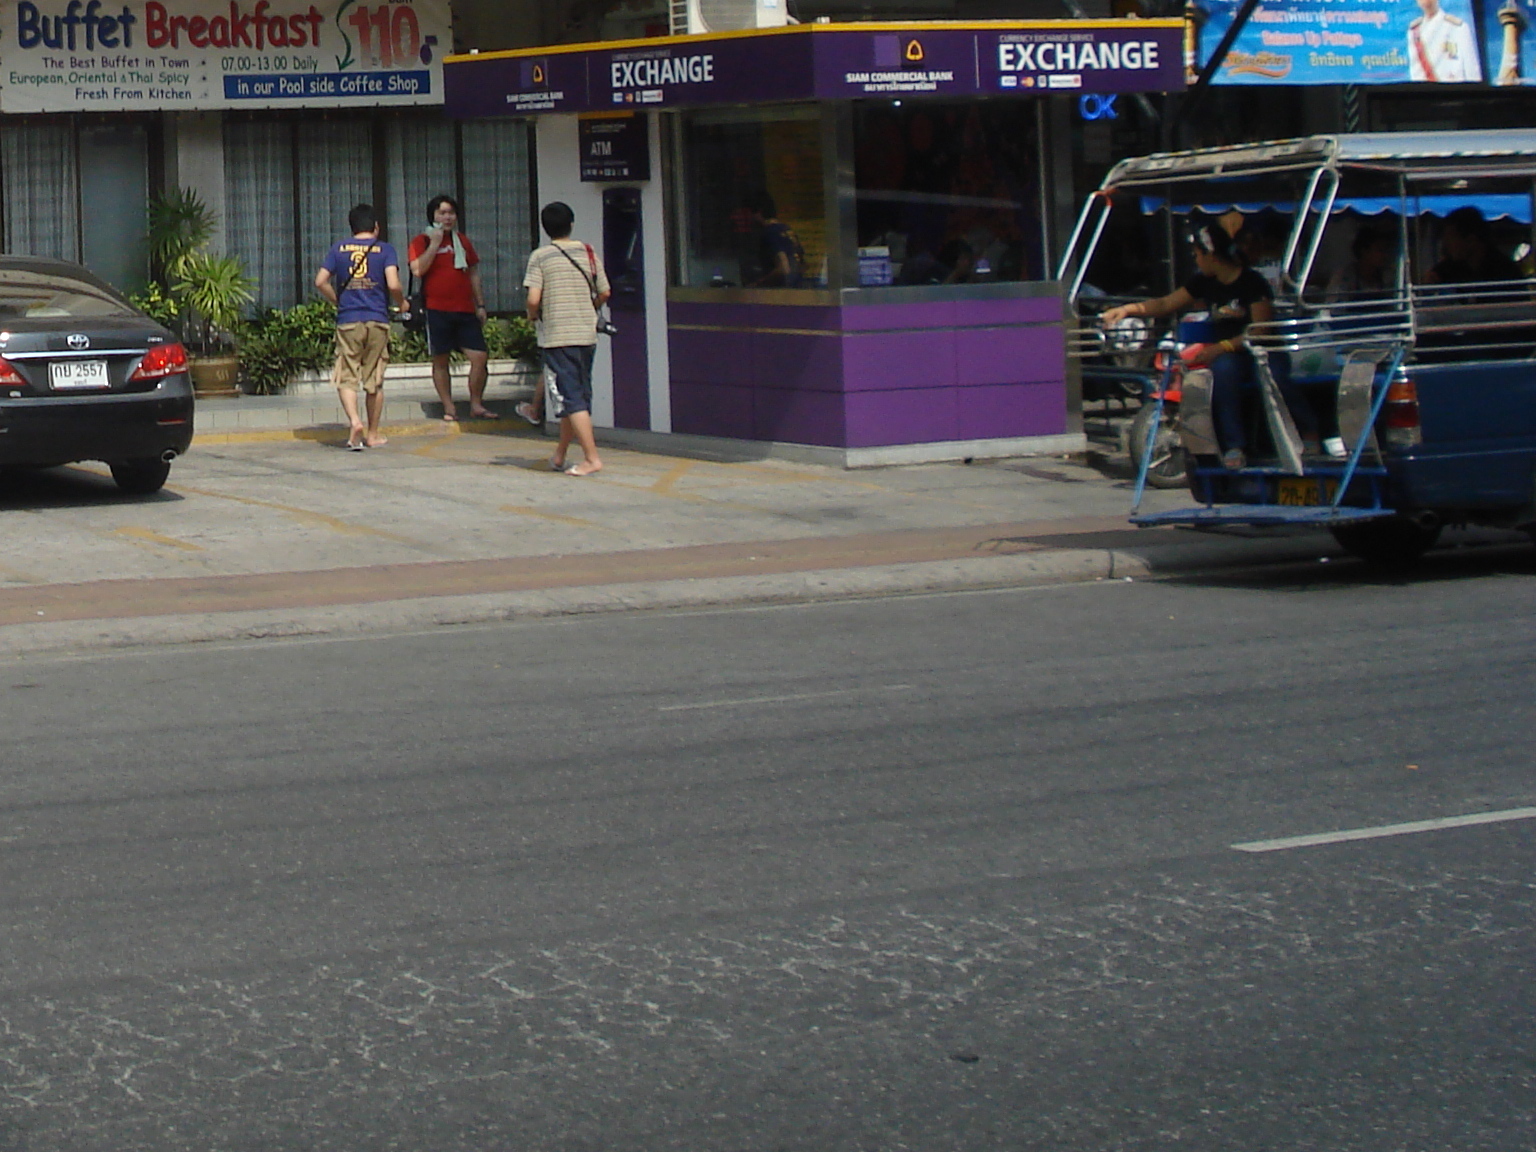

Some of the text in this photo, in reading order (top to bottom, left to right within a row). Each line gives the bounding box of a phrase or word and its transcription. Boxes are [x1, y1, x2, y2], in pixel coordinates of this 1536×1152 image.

[42, 56, 190, 69] The Best Buffet in Town
[221, 55, 319, 72] 07.00-13.00 Daily
[998, 41, 1160, 72] EXCHANGE
[127, 71, 154, 84] Thai
[158, 71, 190, 87] Spicy
[611, 54, 715, 88] EXCHANGE
[845, 70, 954, 83] SIAM COMMERCIAL BANK
[74, 86, 193, 100] Fresh From Kitchen
[237, 74, 420, 96] in our Pool side Coffee Shop
[590, 140, 612, 157] ATM
[75, 363, 104, 378] 2557
